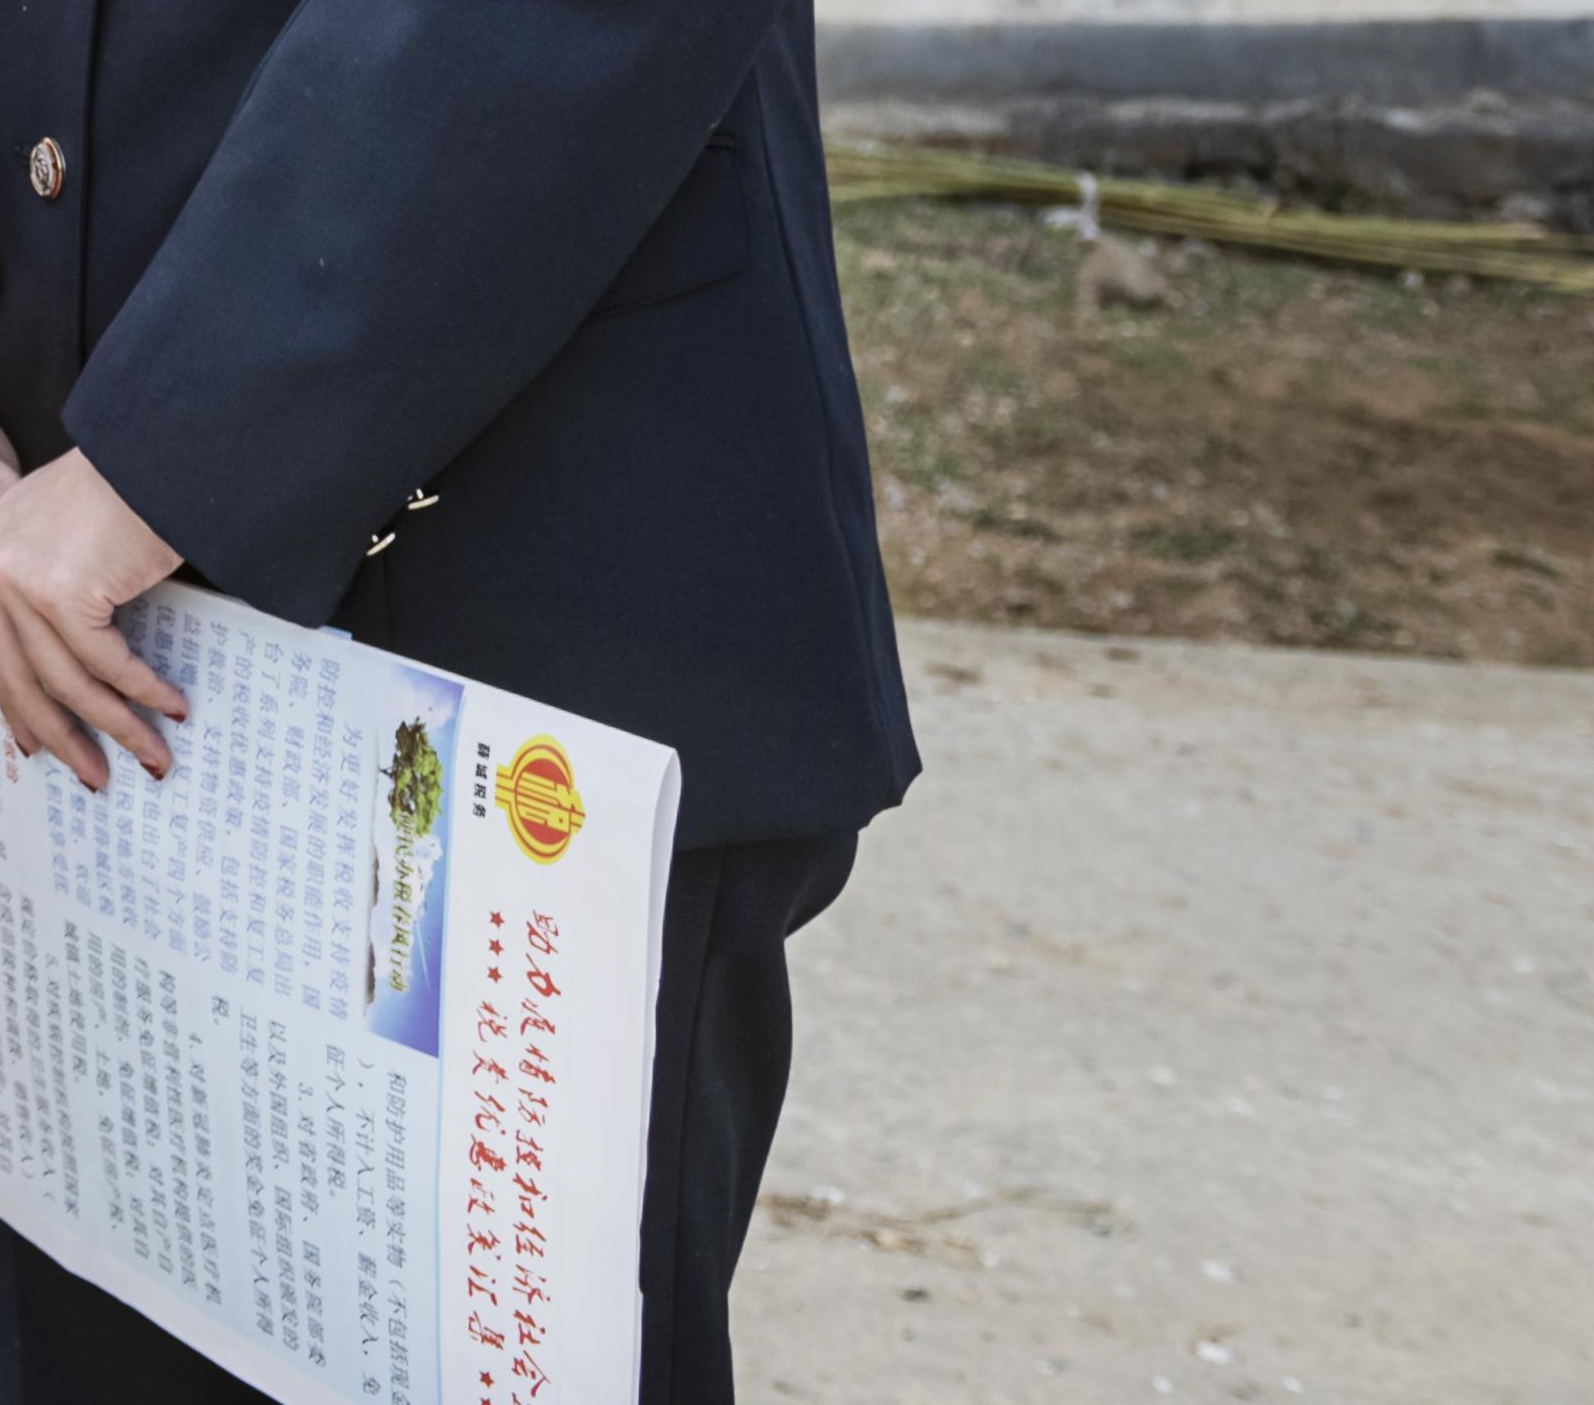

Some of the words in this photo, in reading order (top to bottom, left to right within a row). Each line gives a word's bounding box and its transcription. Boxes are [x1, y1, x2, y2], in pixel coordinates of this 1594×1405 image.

[246, 642, 286, 987] 台了系列支持疫情防控和复工复
[274, 652, 312, 997] 务院、财政部、国家税务总局出
[328, 725, 365, 1021] 为更好发挥税收支持疫情
[472, 742, 491, 818] 薛城税务
[240, 1006, 275, 1336] 卫生等方面的奖金免征个人所得
[326, 1045, 346, 1197] 征个人所得税。
[511, 909, 561, 1405] 助力疫情防控和经济社会
